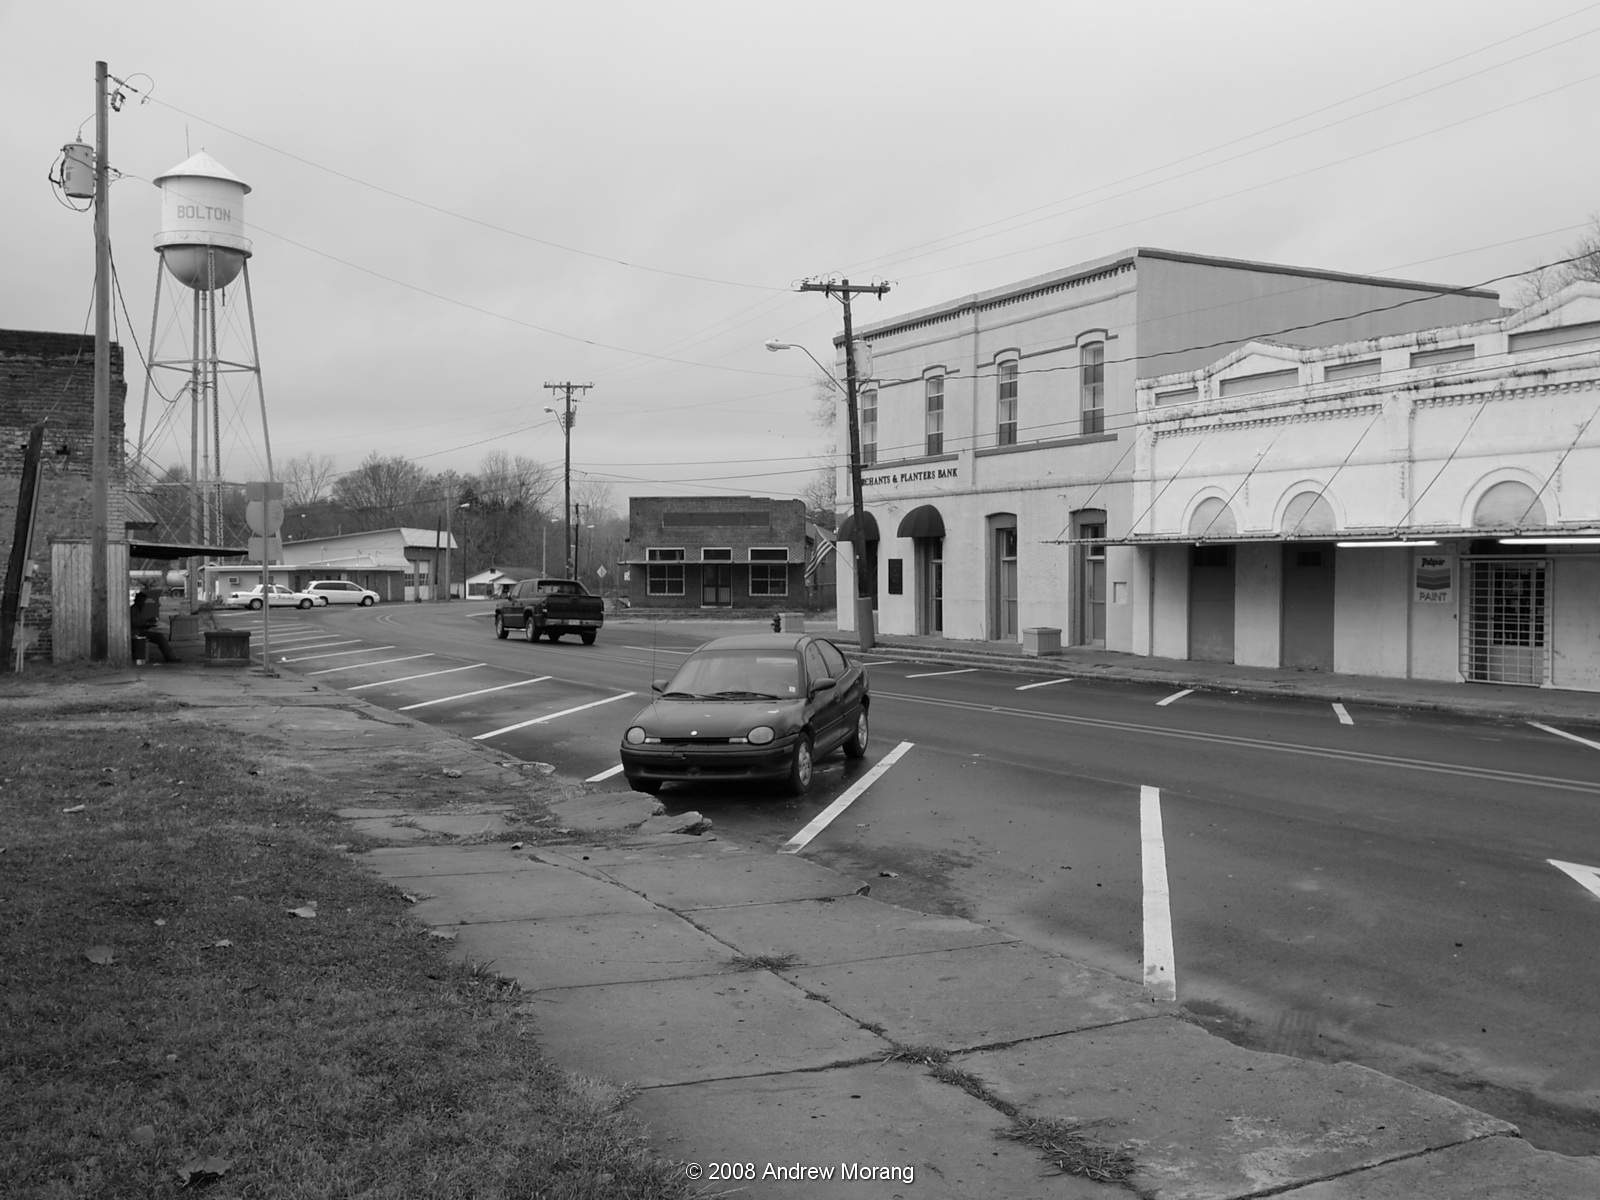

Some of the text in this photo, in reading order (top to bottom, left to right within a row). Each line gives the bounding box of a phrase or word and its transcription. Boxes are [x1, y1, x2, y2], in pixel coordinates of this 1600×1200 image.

[177, 205, 231, 222] BOLTON
[892, 474, 899, 484] &
[900, 470, 936, 483] PLANTERS
[938, 467, 958, 479] BANK
[1419, 592, 1447, 602] PAINT
